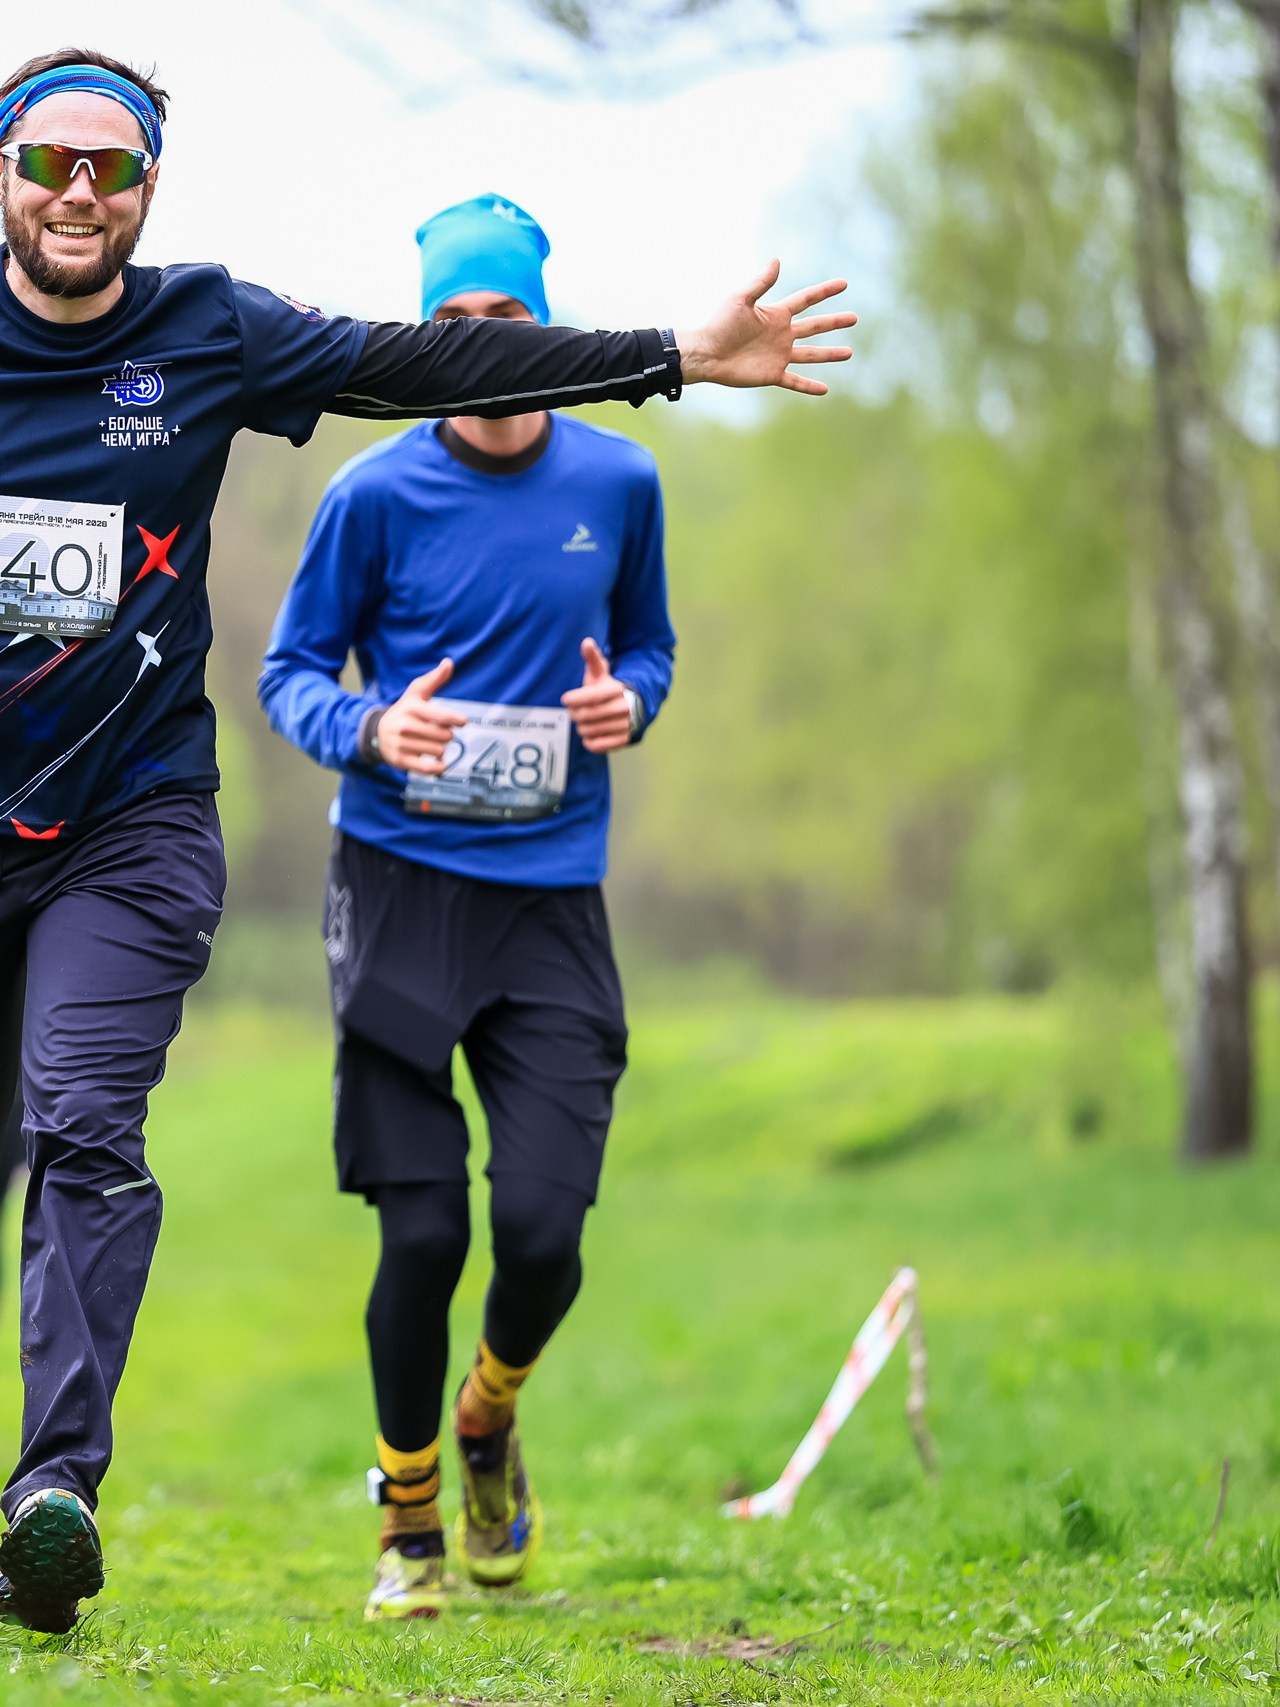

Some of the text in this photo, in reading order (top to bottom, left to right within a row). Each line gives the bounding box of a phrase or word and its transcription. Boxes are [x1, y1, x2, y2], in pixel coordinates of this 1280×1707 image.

[108, 416, 164, 431] БОЛЬШЕ
[101, 431, 170, 447] ЧЕМ ИГРА
[18, 512, 45, 522] ТРЕЙЛ
[47, 515, 63, 524] 9-10
[65, 517, 84, 526] МАЯ
[85, 519, 108, 528] 2026
[436, 736, 543, 790] 248
